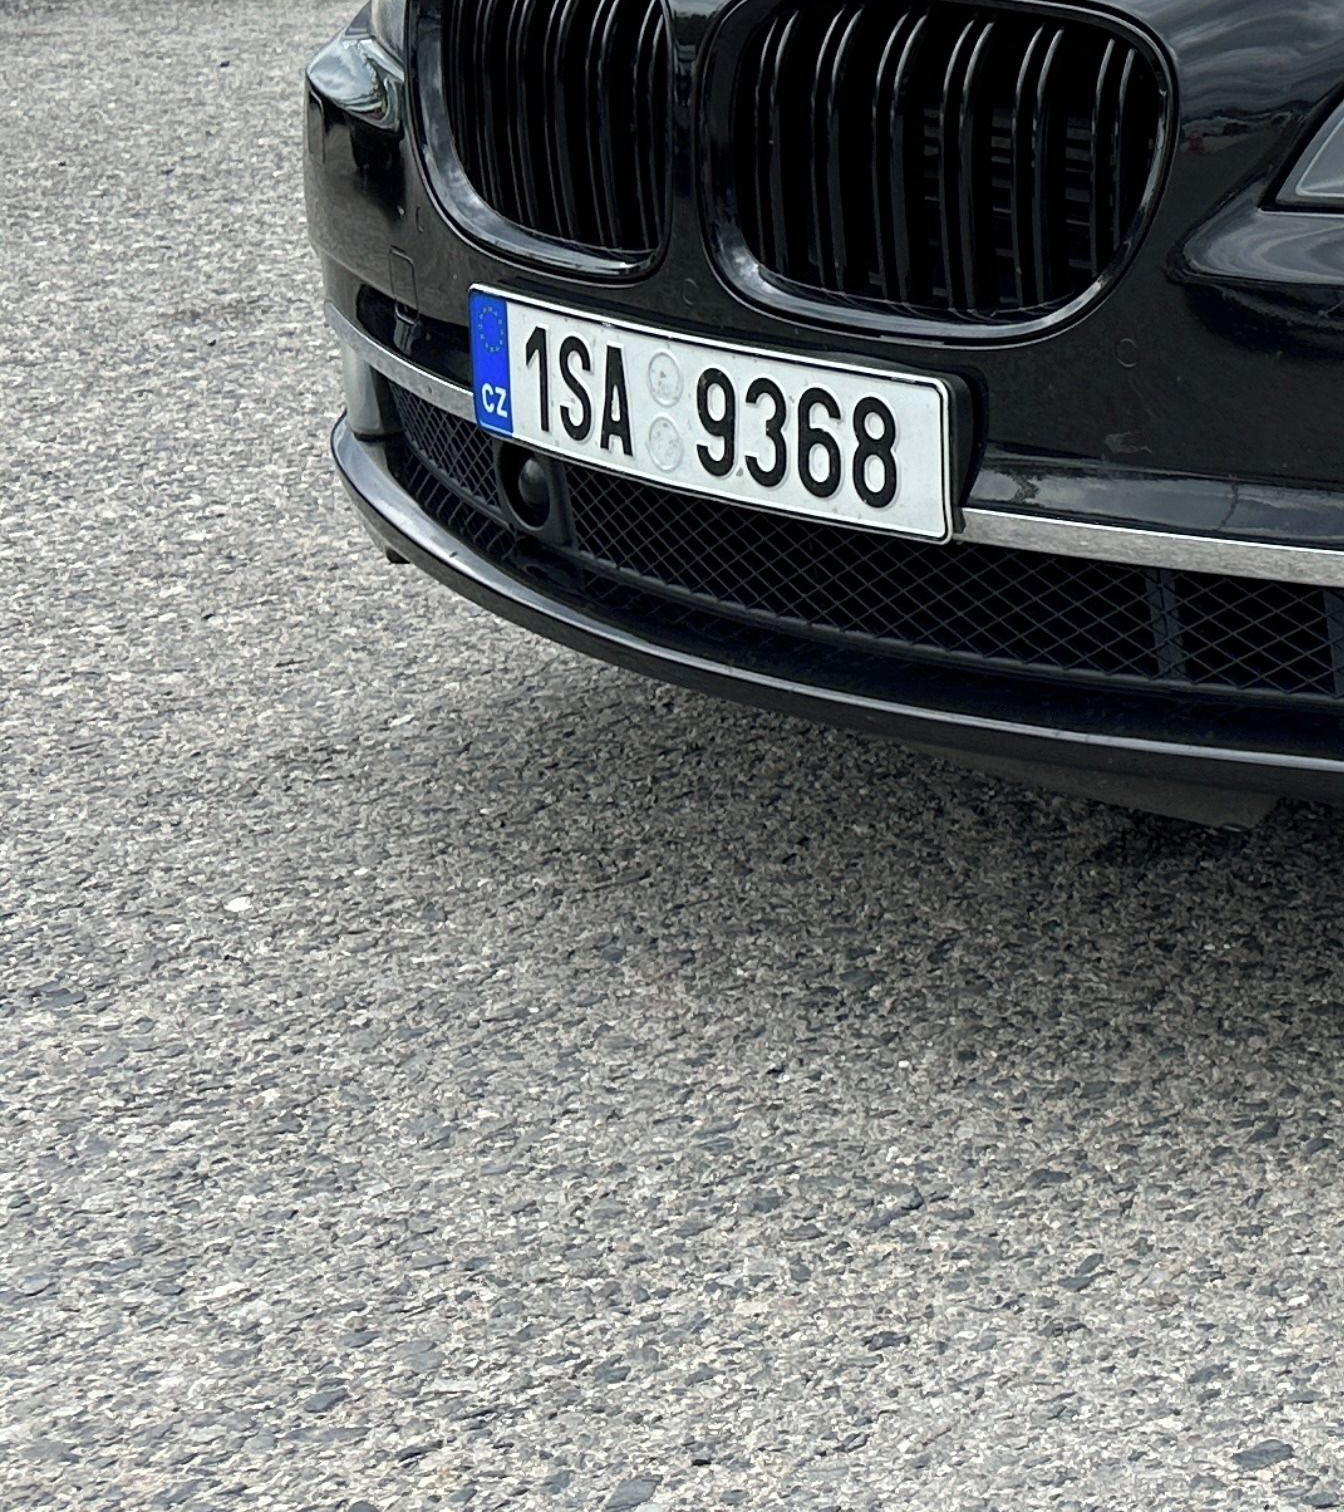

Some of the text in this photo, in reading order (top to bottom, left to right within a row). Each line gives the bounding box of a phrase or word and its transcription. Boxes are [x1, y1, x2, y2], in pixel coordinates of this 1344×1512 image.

[481, 381, 509, 419] CZ
[525, 326, 898, 510] 1SA 9368
